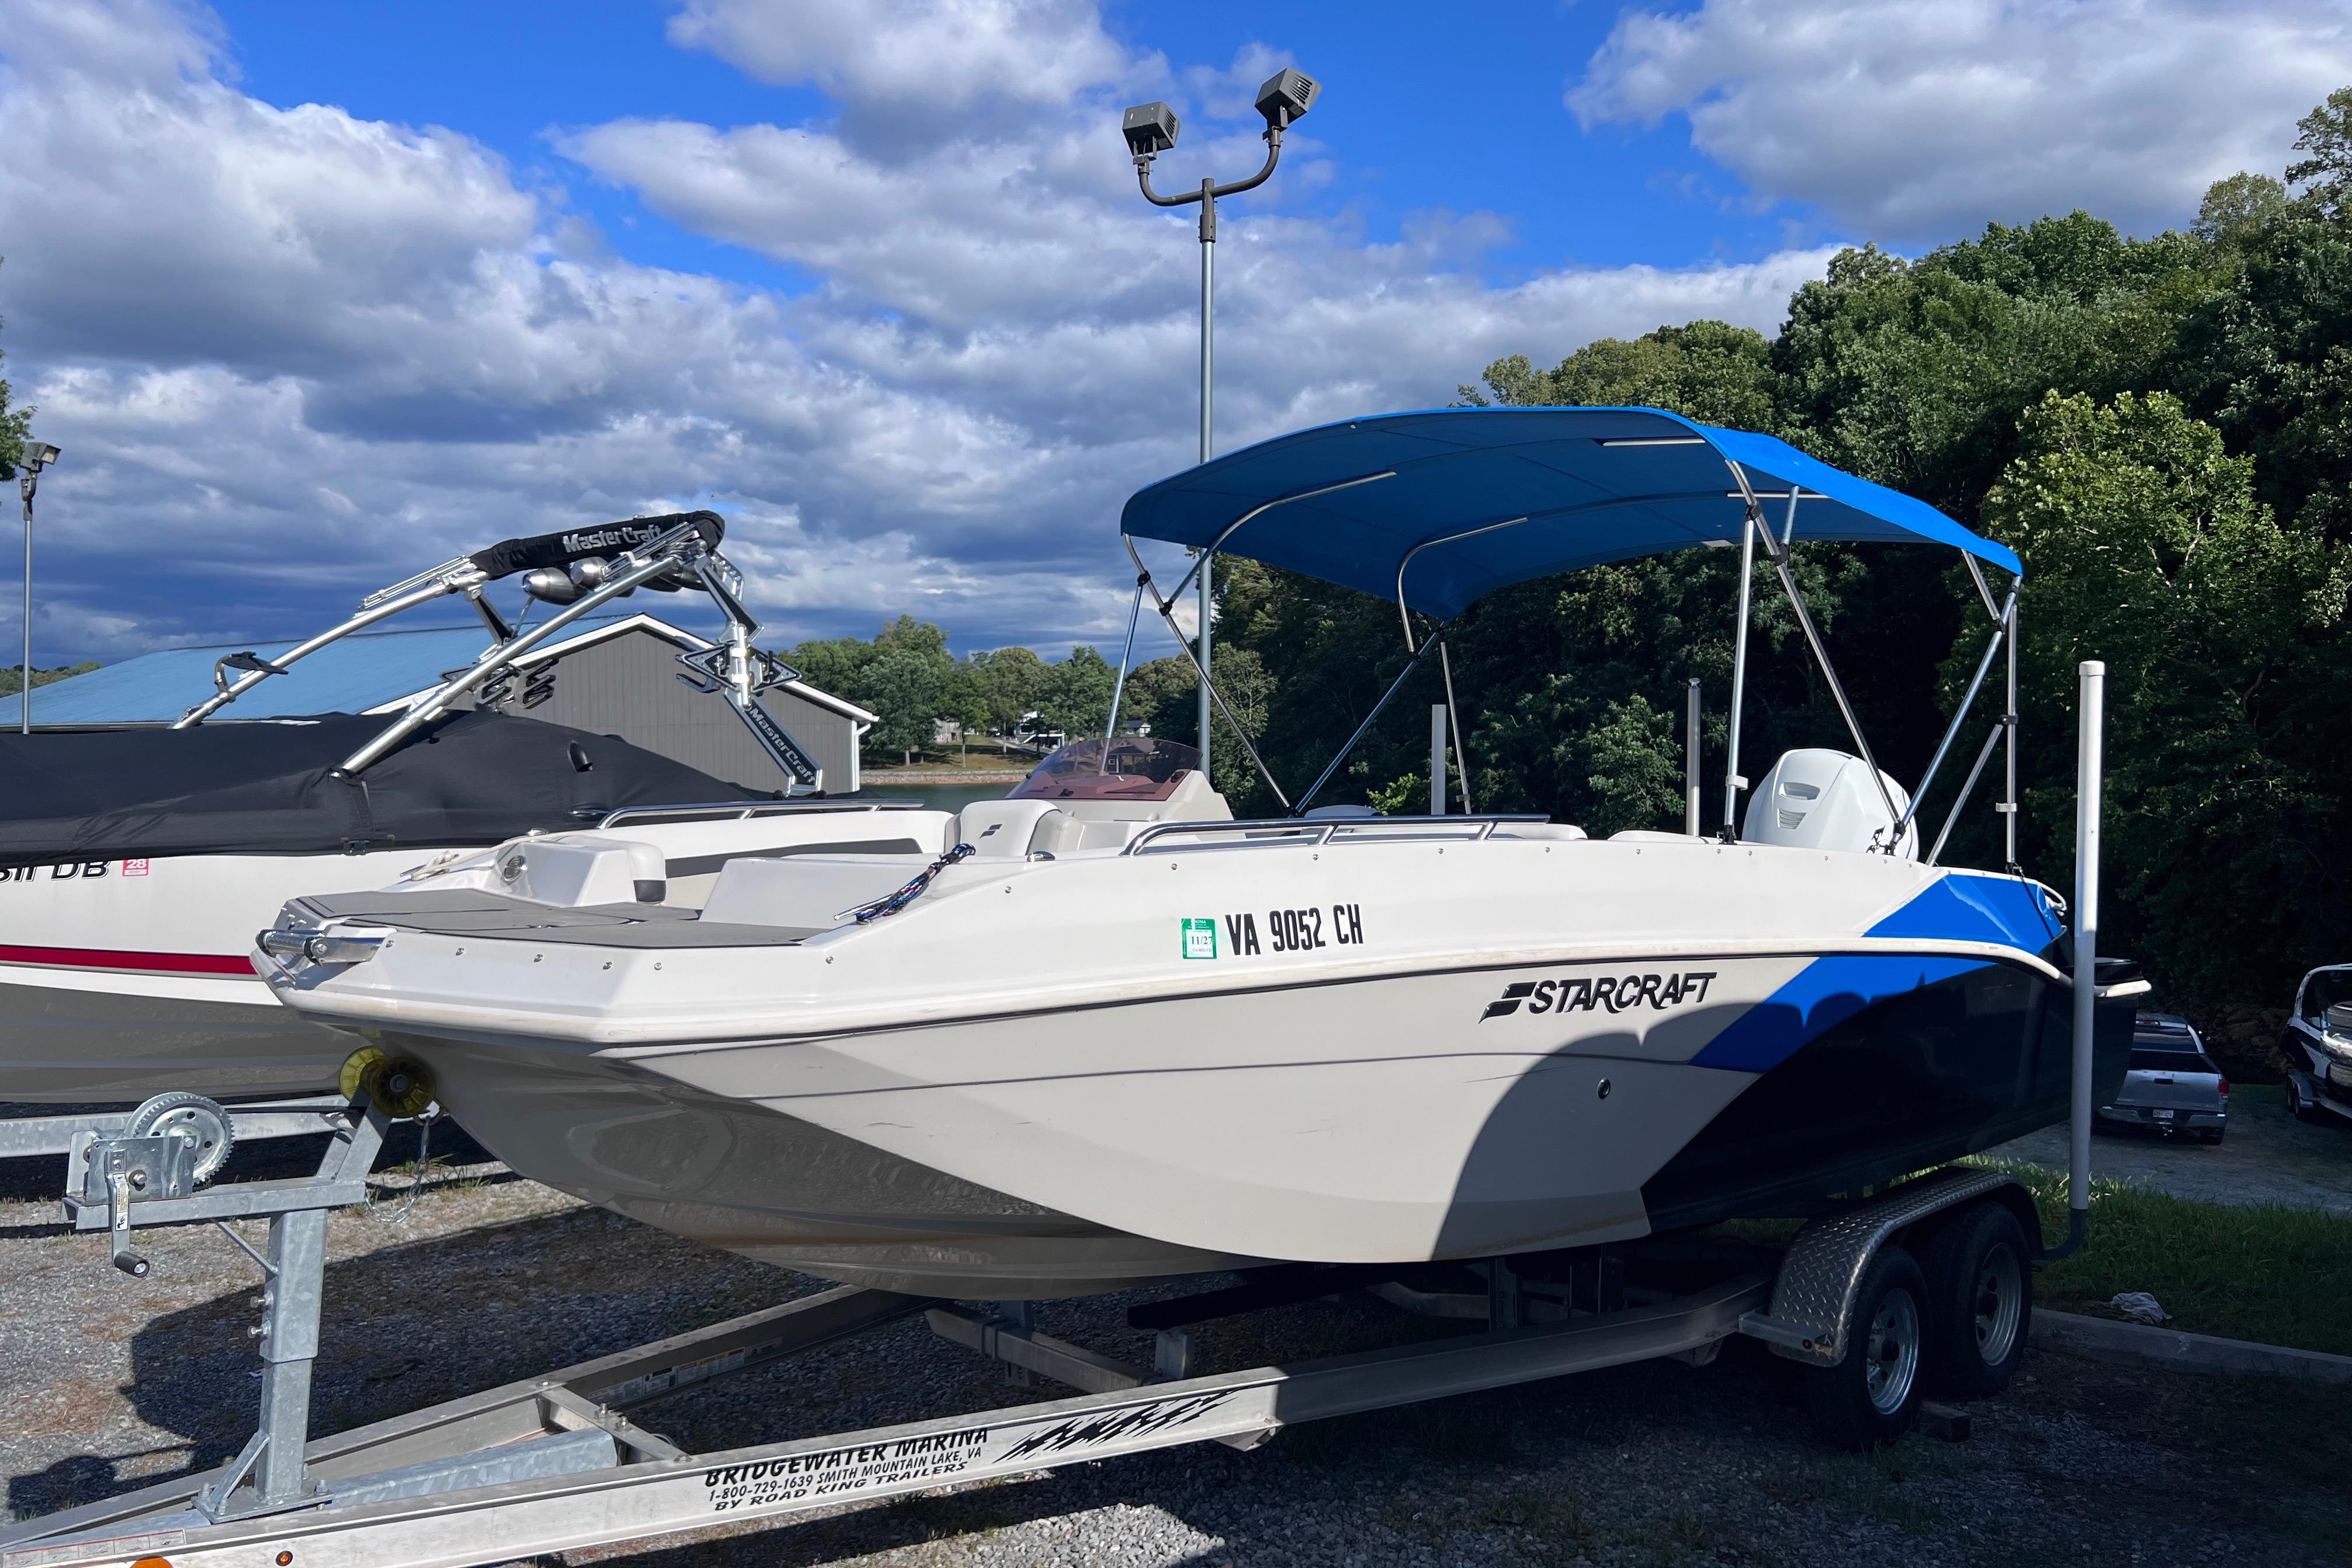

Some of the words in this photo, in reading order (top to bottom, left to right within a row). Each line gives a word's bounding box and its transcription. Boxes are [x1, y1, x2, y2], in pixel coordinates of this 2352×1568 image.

[563, 524, 662, 552] MasterCraft
[749, 708, 816, 783] MasterCraft
[127, 859, 146, 869] 28
[1191, 936, 1213, 944] 11/27
[1225, 913, 1261, 956] VA
[1269, 907, 1326, 952] 9052
[1333, 904, 1364, 944] CH
[1528, 972, 1717, 1014] STARCRAFT
[705, 1444, 888, 1487] BRIDGEWATER
[895, 1428, 988, 1457] MARINA
[709, 1475, 814, 1502] 1-800-729-1639
[817, 1466, 858, 1484] SMITH
[862, 1456, 928, 1477] MOUNTAIN
[932, 1450, 963, 1465] LAKE,
[968, 1447, 981, 1458] VA
[715, 1499, 743, 1511] BY
[750, 1489, 808, 1506] ROAD
[816, 1479, 867, 1495] KING
[876, 1461, 968, 1485] TRAILERS
